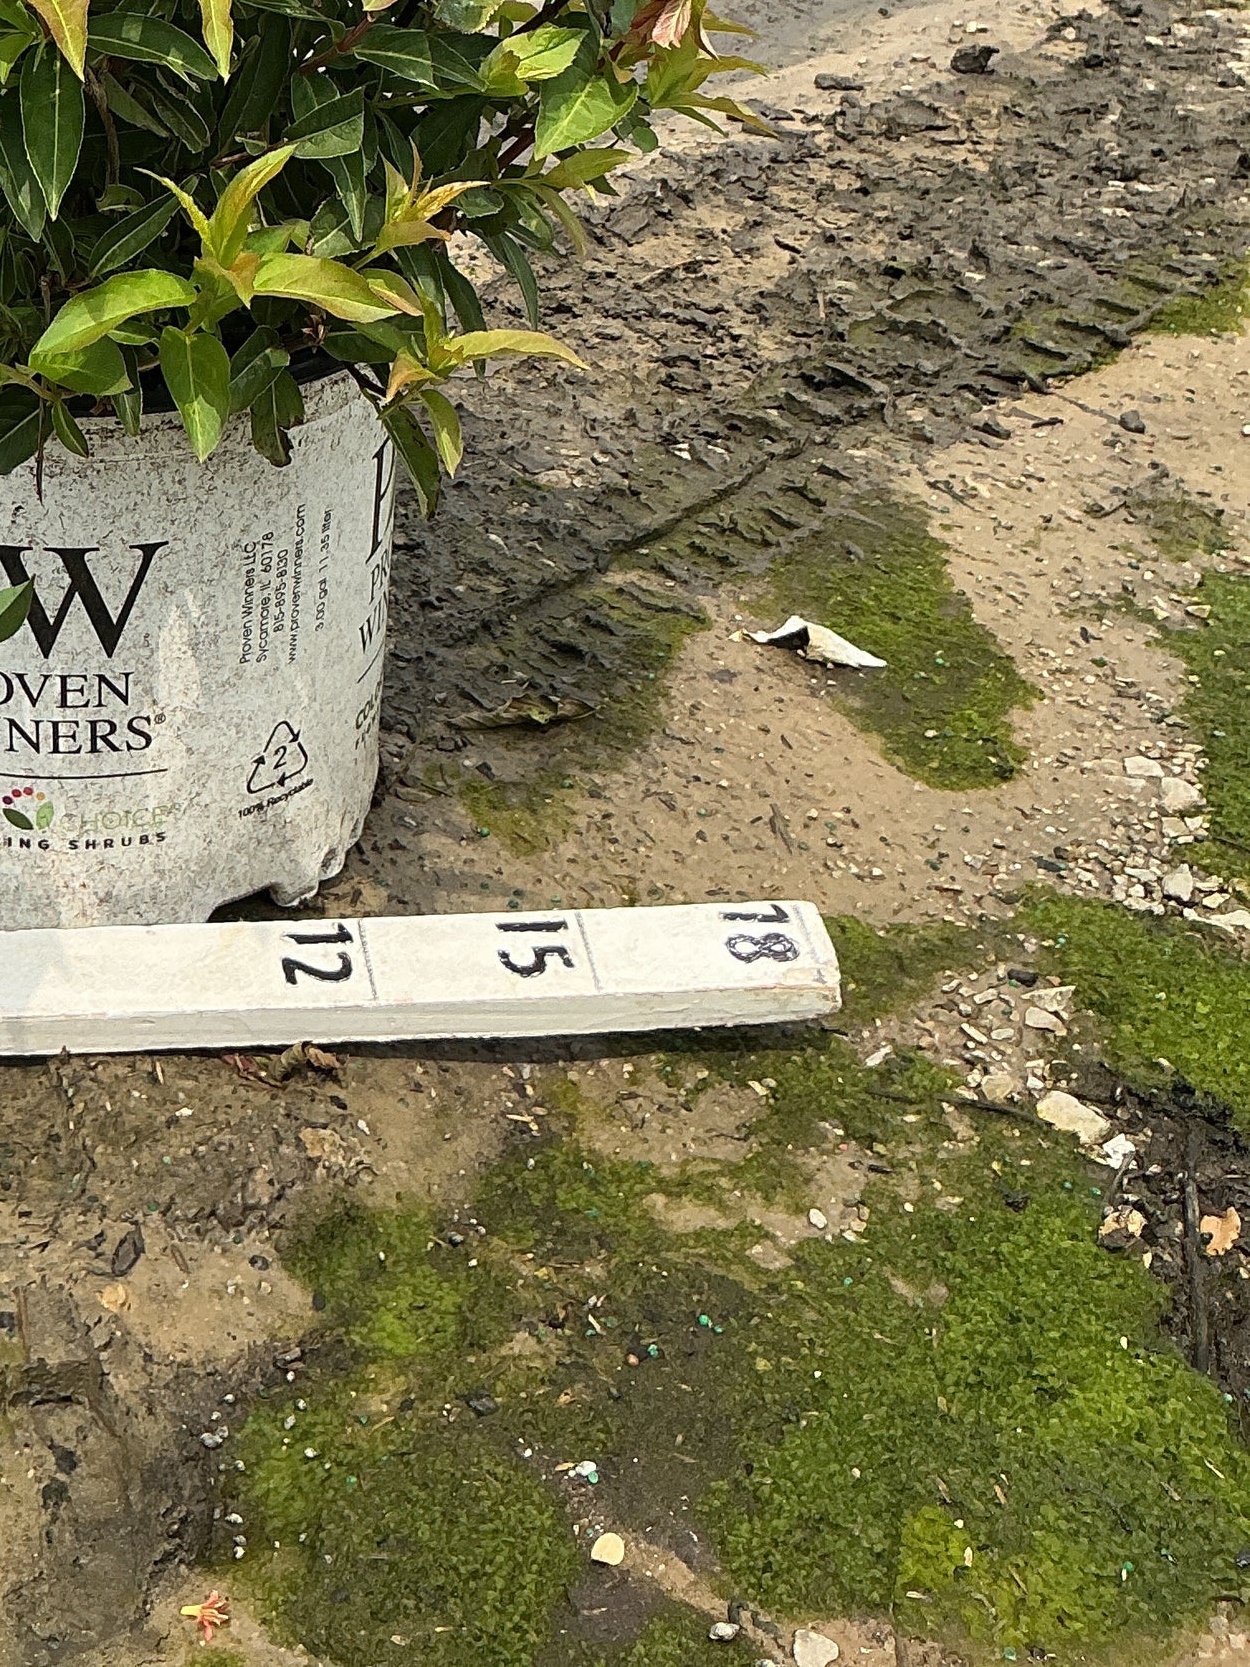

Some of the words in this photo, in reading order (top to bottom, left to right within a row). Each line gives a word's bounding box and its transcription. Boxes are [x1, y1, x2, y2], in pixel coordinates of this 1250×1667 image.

[244, 541, 257, 567] LLC
[260, 531, 274, 573] 60178
[241, 568, 256, 619] Winners
[260, 579, 272, 592] IL
[273, 548, 289, 633] 815-895-8130
[288, 503, 306, 665] www.provenwinners.com
[317, 577, 328, 600] gal
[239, 620, 253, 664] Proven
[256, 592, 272, 664] Sycamore,
[273, 745, 288, 770] 2
[266, 778, 314, 809] Recyclable
[68, 831, 167, 851] SHRUBS
[281, 921, 353, 986] 12
[495, 919, 575, 978] 15
[719, 903, 800, 964] 18
